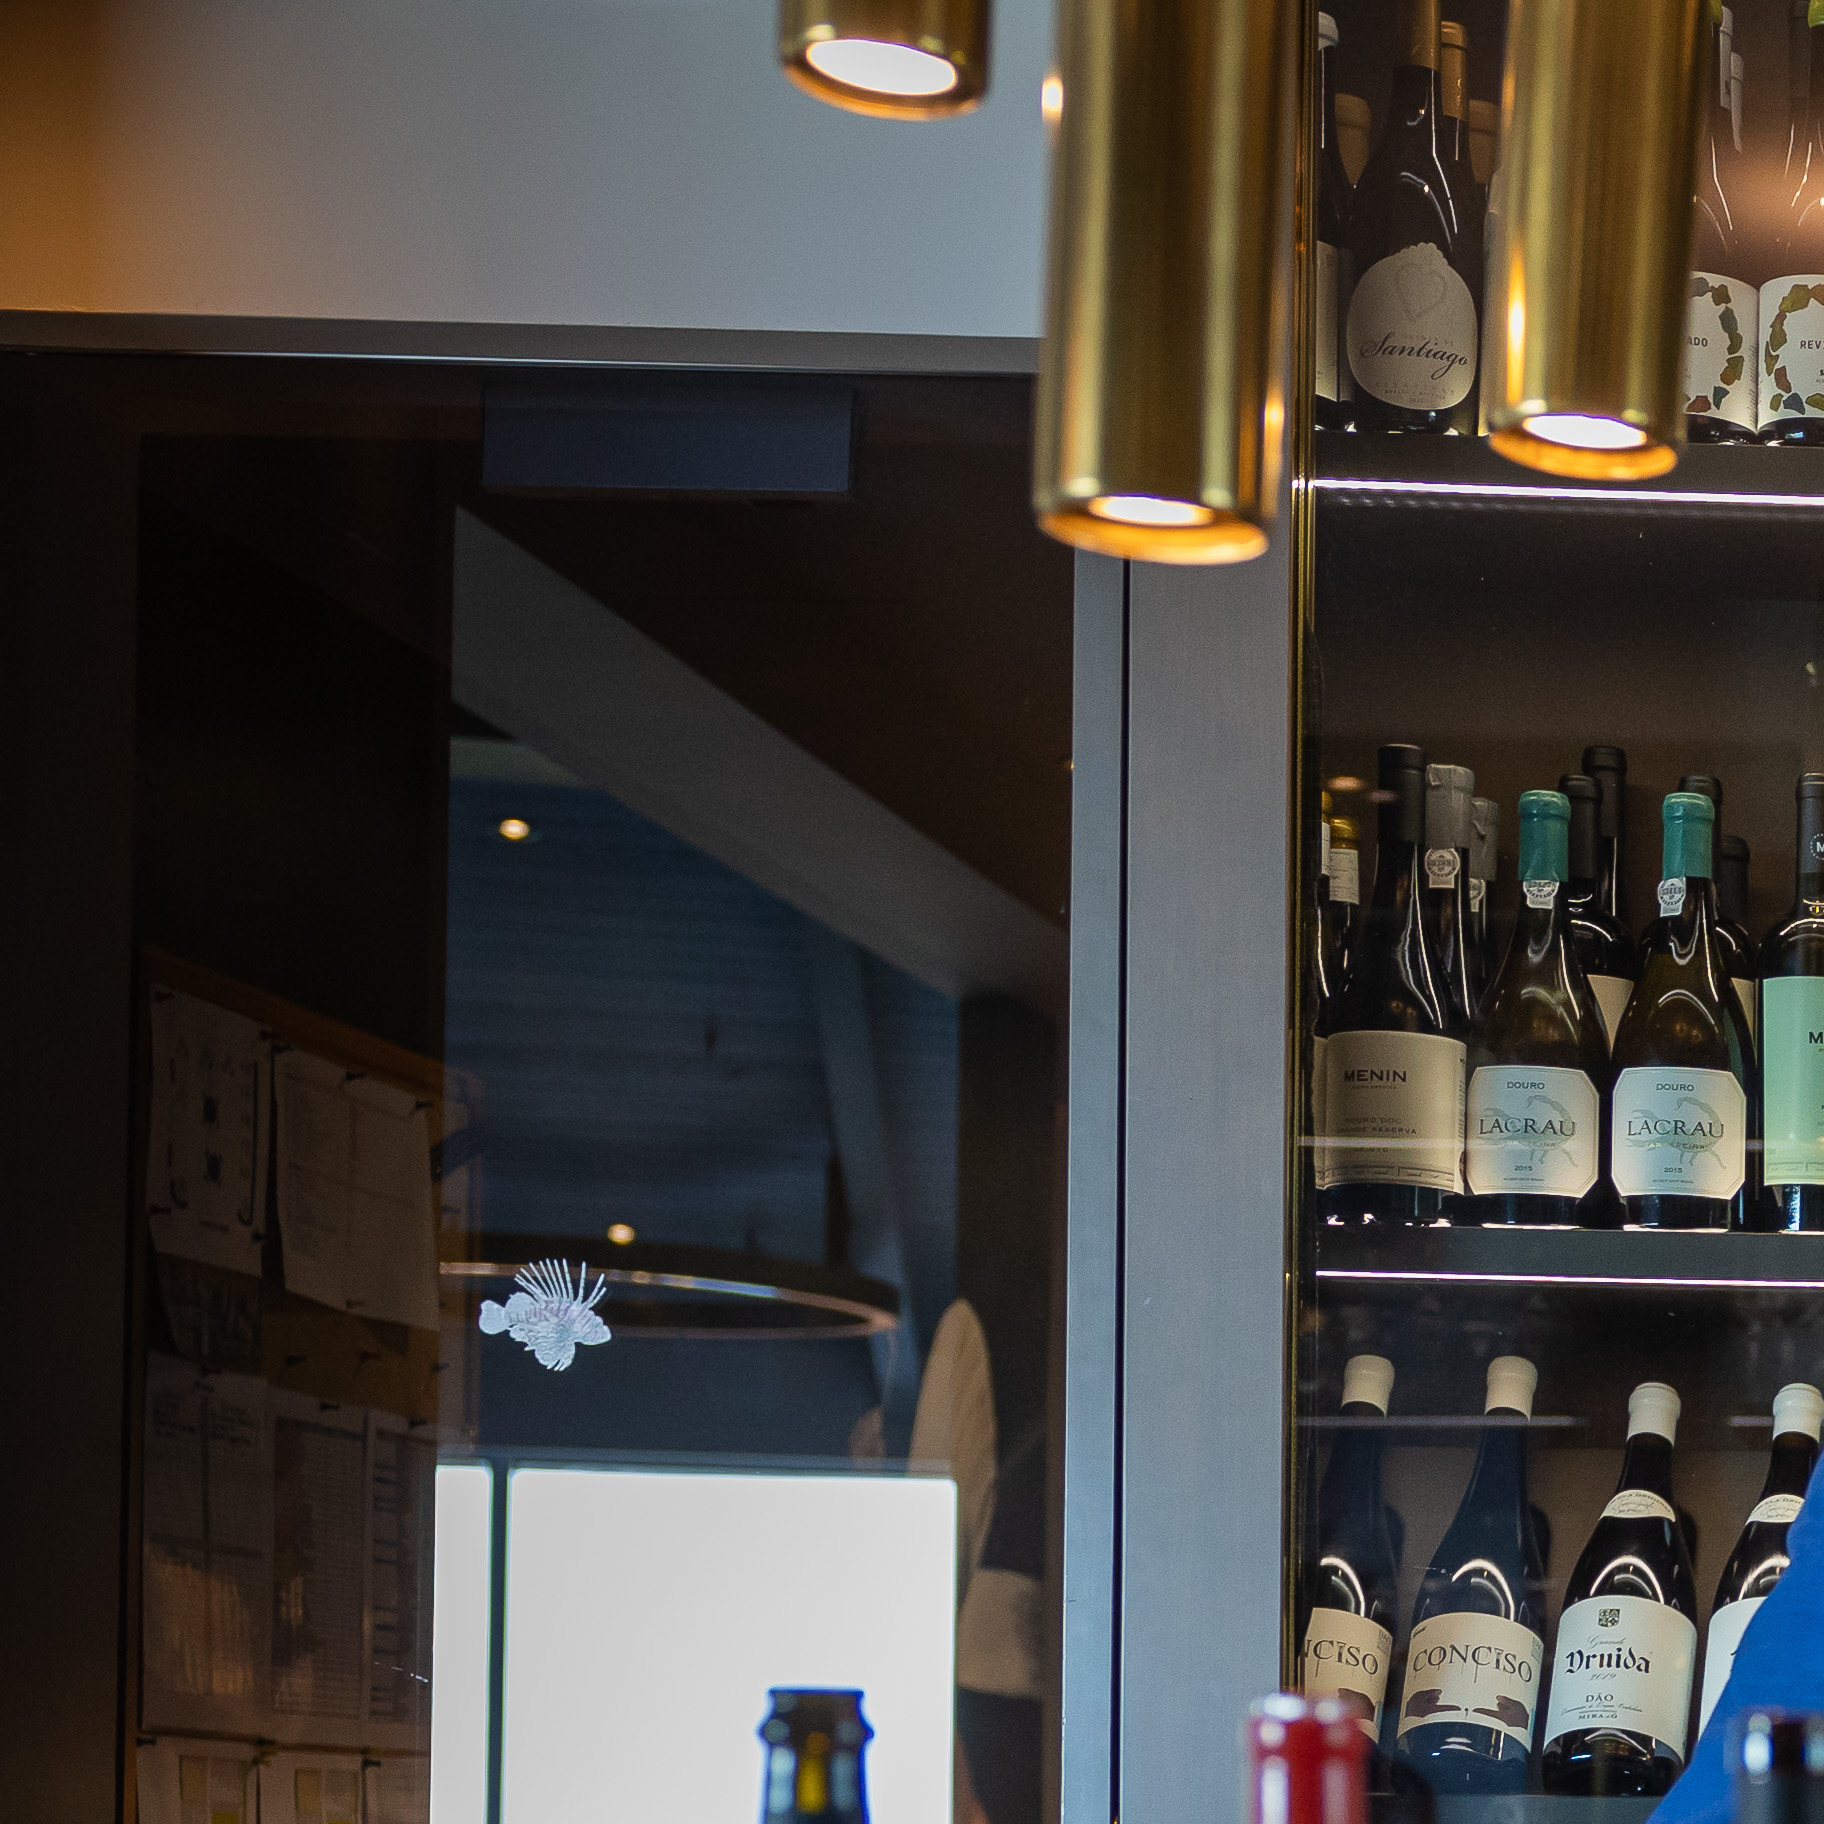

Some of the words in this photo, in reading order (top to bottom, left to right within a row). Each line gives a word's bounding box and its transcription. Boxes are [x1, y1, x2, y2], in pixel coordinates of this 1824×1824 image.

[1360, 332, 1468, 380] Santiago
[1344, 1069, 1407, 1083] MENIN
[1507, 1081, 1545, 1090] DOURO
[1656, 1083, 1695, 1092] DOURO
[1479, 1118, 1577, 1137] LACRAU
[1627, 1119, 1724, 1138] LACRAU
[1411, 1644, 1534, 1684] CONCISO
[1585, 1692, 1614, 1703] DÃO
